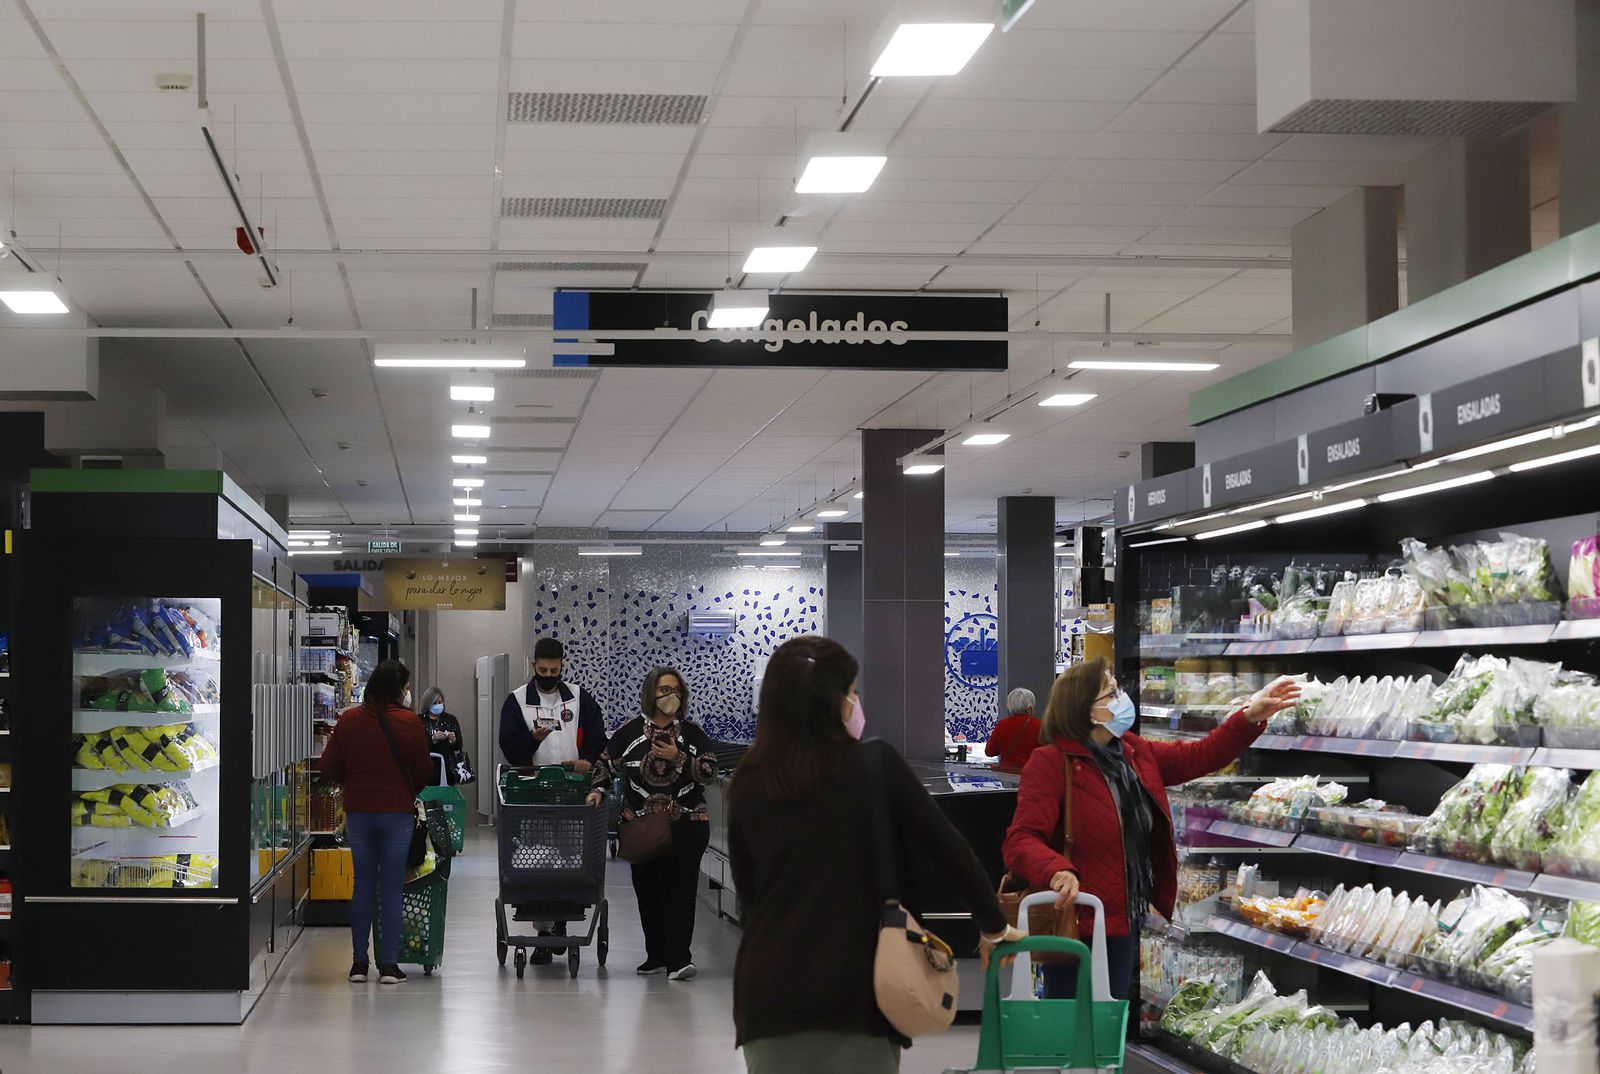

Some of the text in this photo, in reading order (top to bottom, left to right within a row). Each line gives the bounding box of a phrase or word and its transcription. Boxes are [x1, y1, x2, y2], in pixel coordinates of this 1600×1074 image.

[1457, 393, 1501, 425] ENSALADAS
[1327, 439, 1361, 463] ENSALADAS
[1225, 469, 1252, 490] ENSALADAS
[1147, 489, 1166, 506] HERVIDOS
[405, 579, 484, 603] para dar lo mejor
